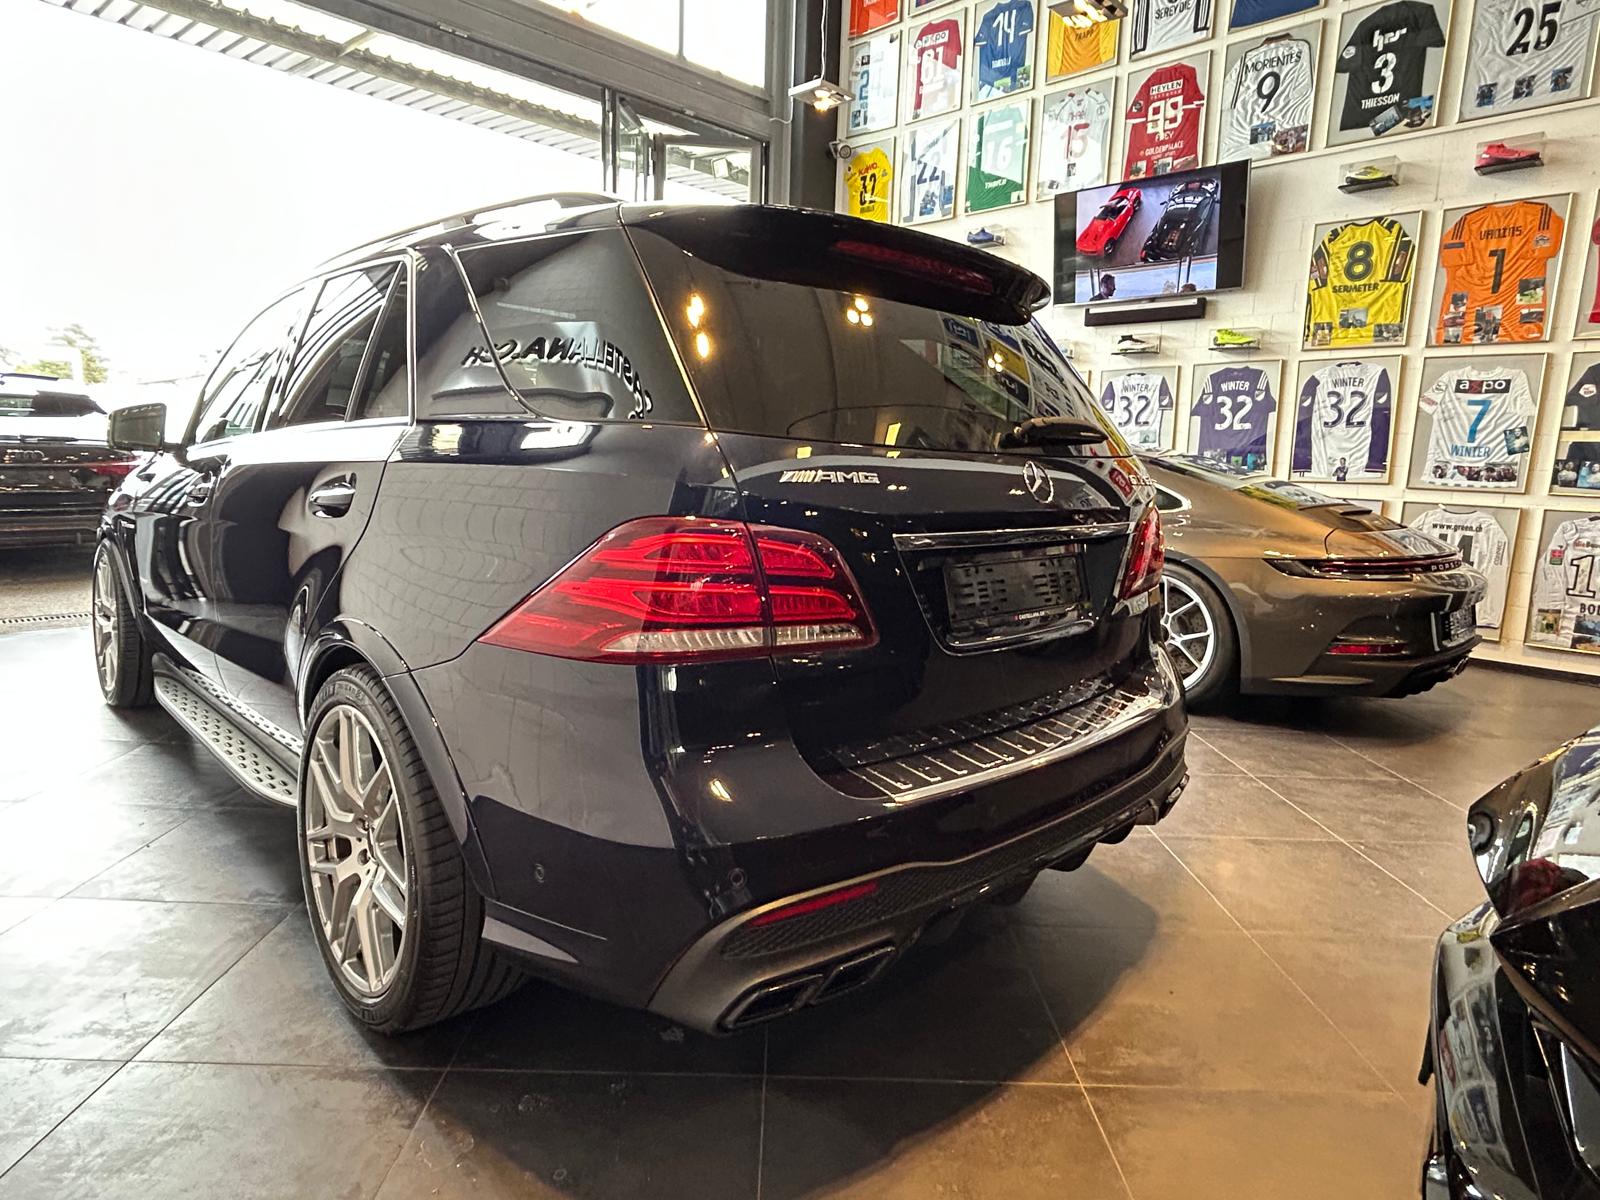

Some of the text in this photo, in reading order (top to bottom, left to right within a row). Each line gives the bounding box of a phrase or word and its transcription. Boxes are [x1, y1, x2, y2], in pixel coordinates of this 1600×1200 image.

[993, 9, 1017, 47] 14
[1155, 4, 1179, 20] SEREY
[1506, 1, 1561, 56] 25
[1244, 50, 1302, 75] MORIENTES
[1371, 52, 1397, 94] 3
[1151, 80, 1182, 94] HEYLEN
[1257, 71, 1281, 113] 9
[1361, 93, 1400, 110] THIESSON
[1147, 95, 1184, 135] 99
[1343, 240, 1375, 282] 8
[1488, 248, 1506, 294] 1
[1331, 282, 1380, 294] SERMETER
[1122, 383, 1150, 393] WINTER
[1220, 380, 1250, 392] WINTER
[1331, 376, 1365, 389] WINTER
[1118, 395, 1151, 427] 32
[1214, 395, 1253, 430] 32
[1323, 390, 1367, 428] 32
[1467, 400, 1493, 443] 7
[1450, 443, 1491, 458] WINTER
[1432, 523, 1483, 533] www.green.ch
[1566, 555, 1597, 599] 1
